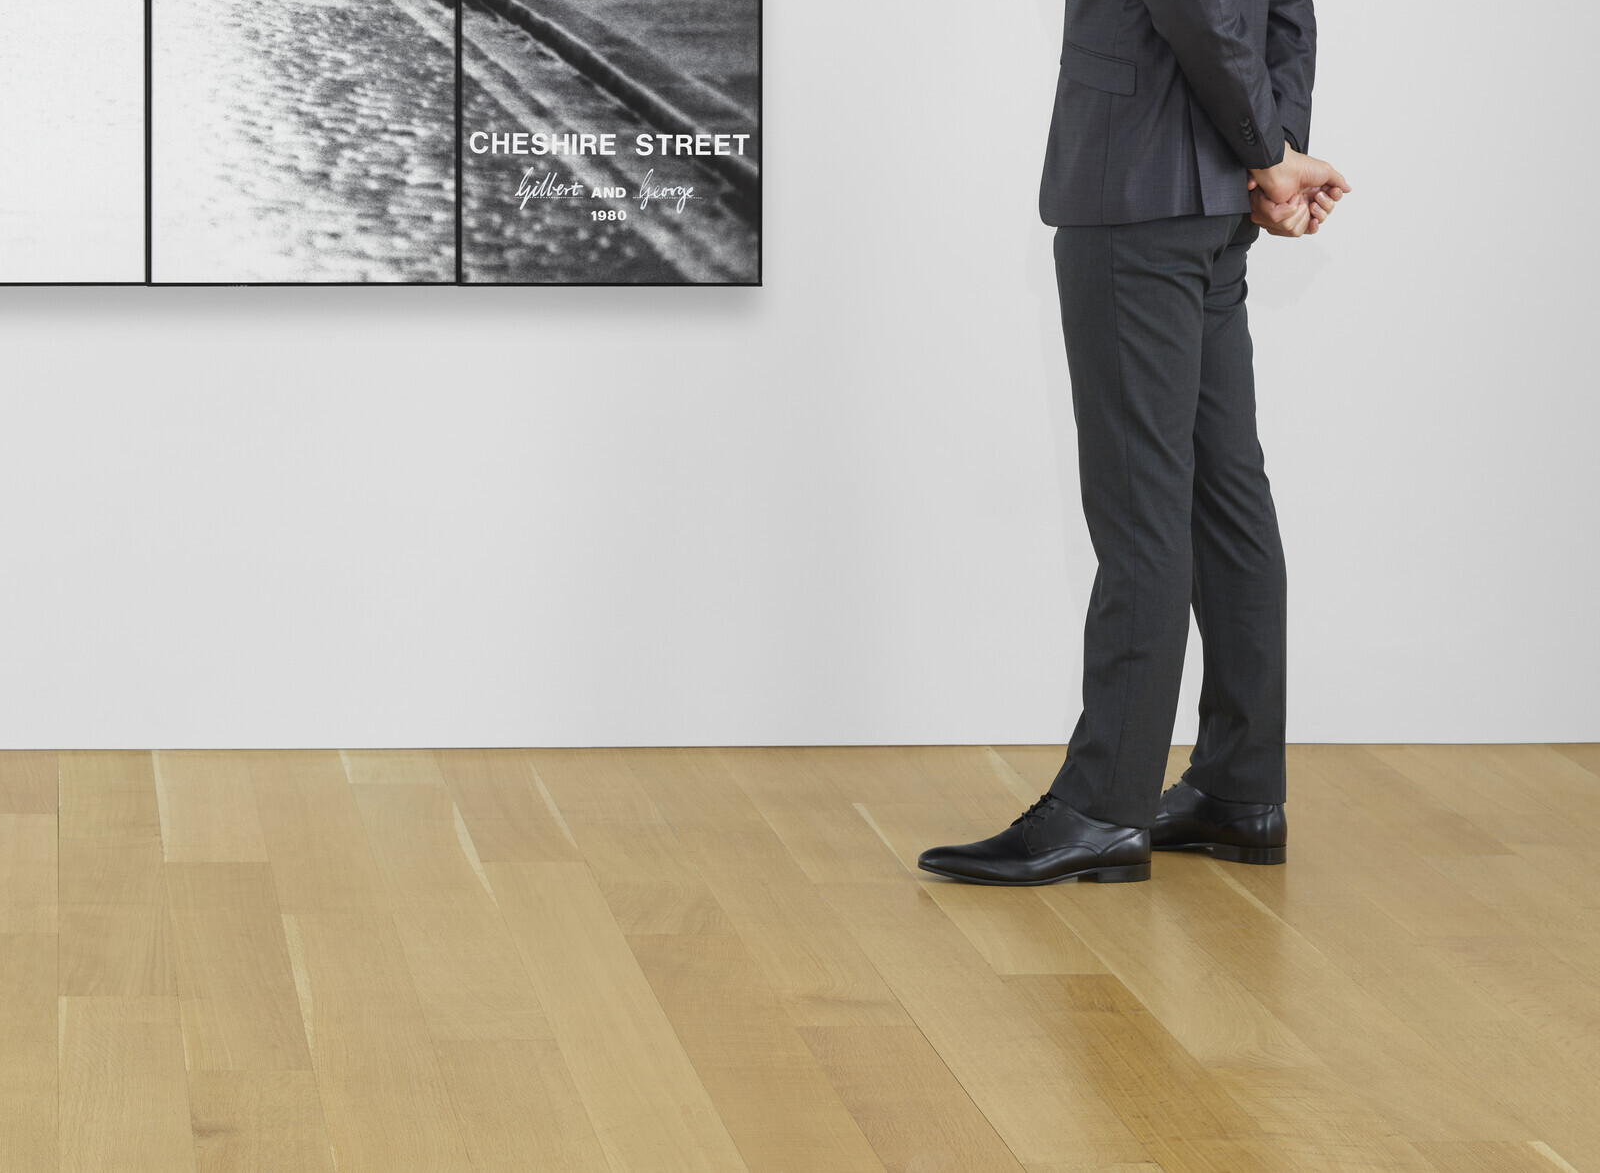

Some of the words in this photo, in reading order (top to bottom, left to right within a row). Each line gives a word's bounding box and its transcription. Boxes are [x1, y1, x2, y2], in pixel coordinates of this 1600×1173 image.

[469, 131, 617, 156] CHESHIRE
[635, 133, 751, 157] STREET
[514, 166, 584, 210] Gilbert
[590, 187, 627, 199] AND
[639, 168, 695, 214] George
[590, 210, 627, 222] 1980
